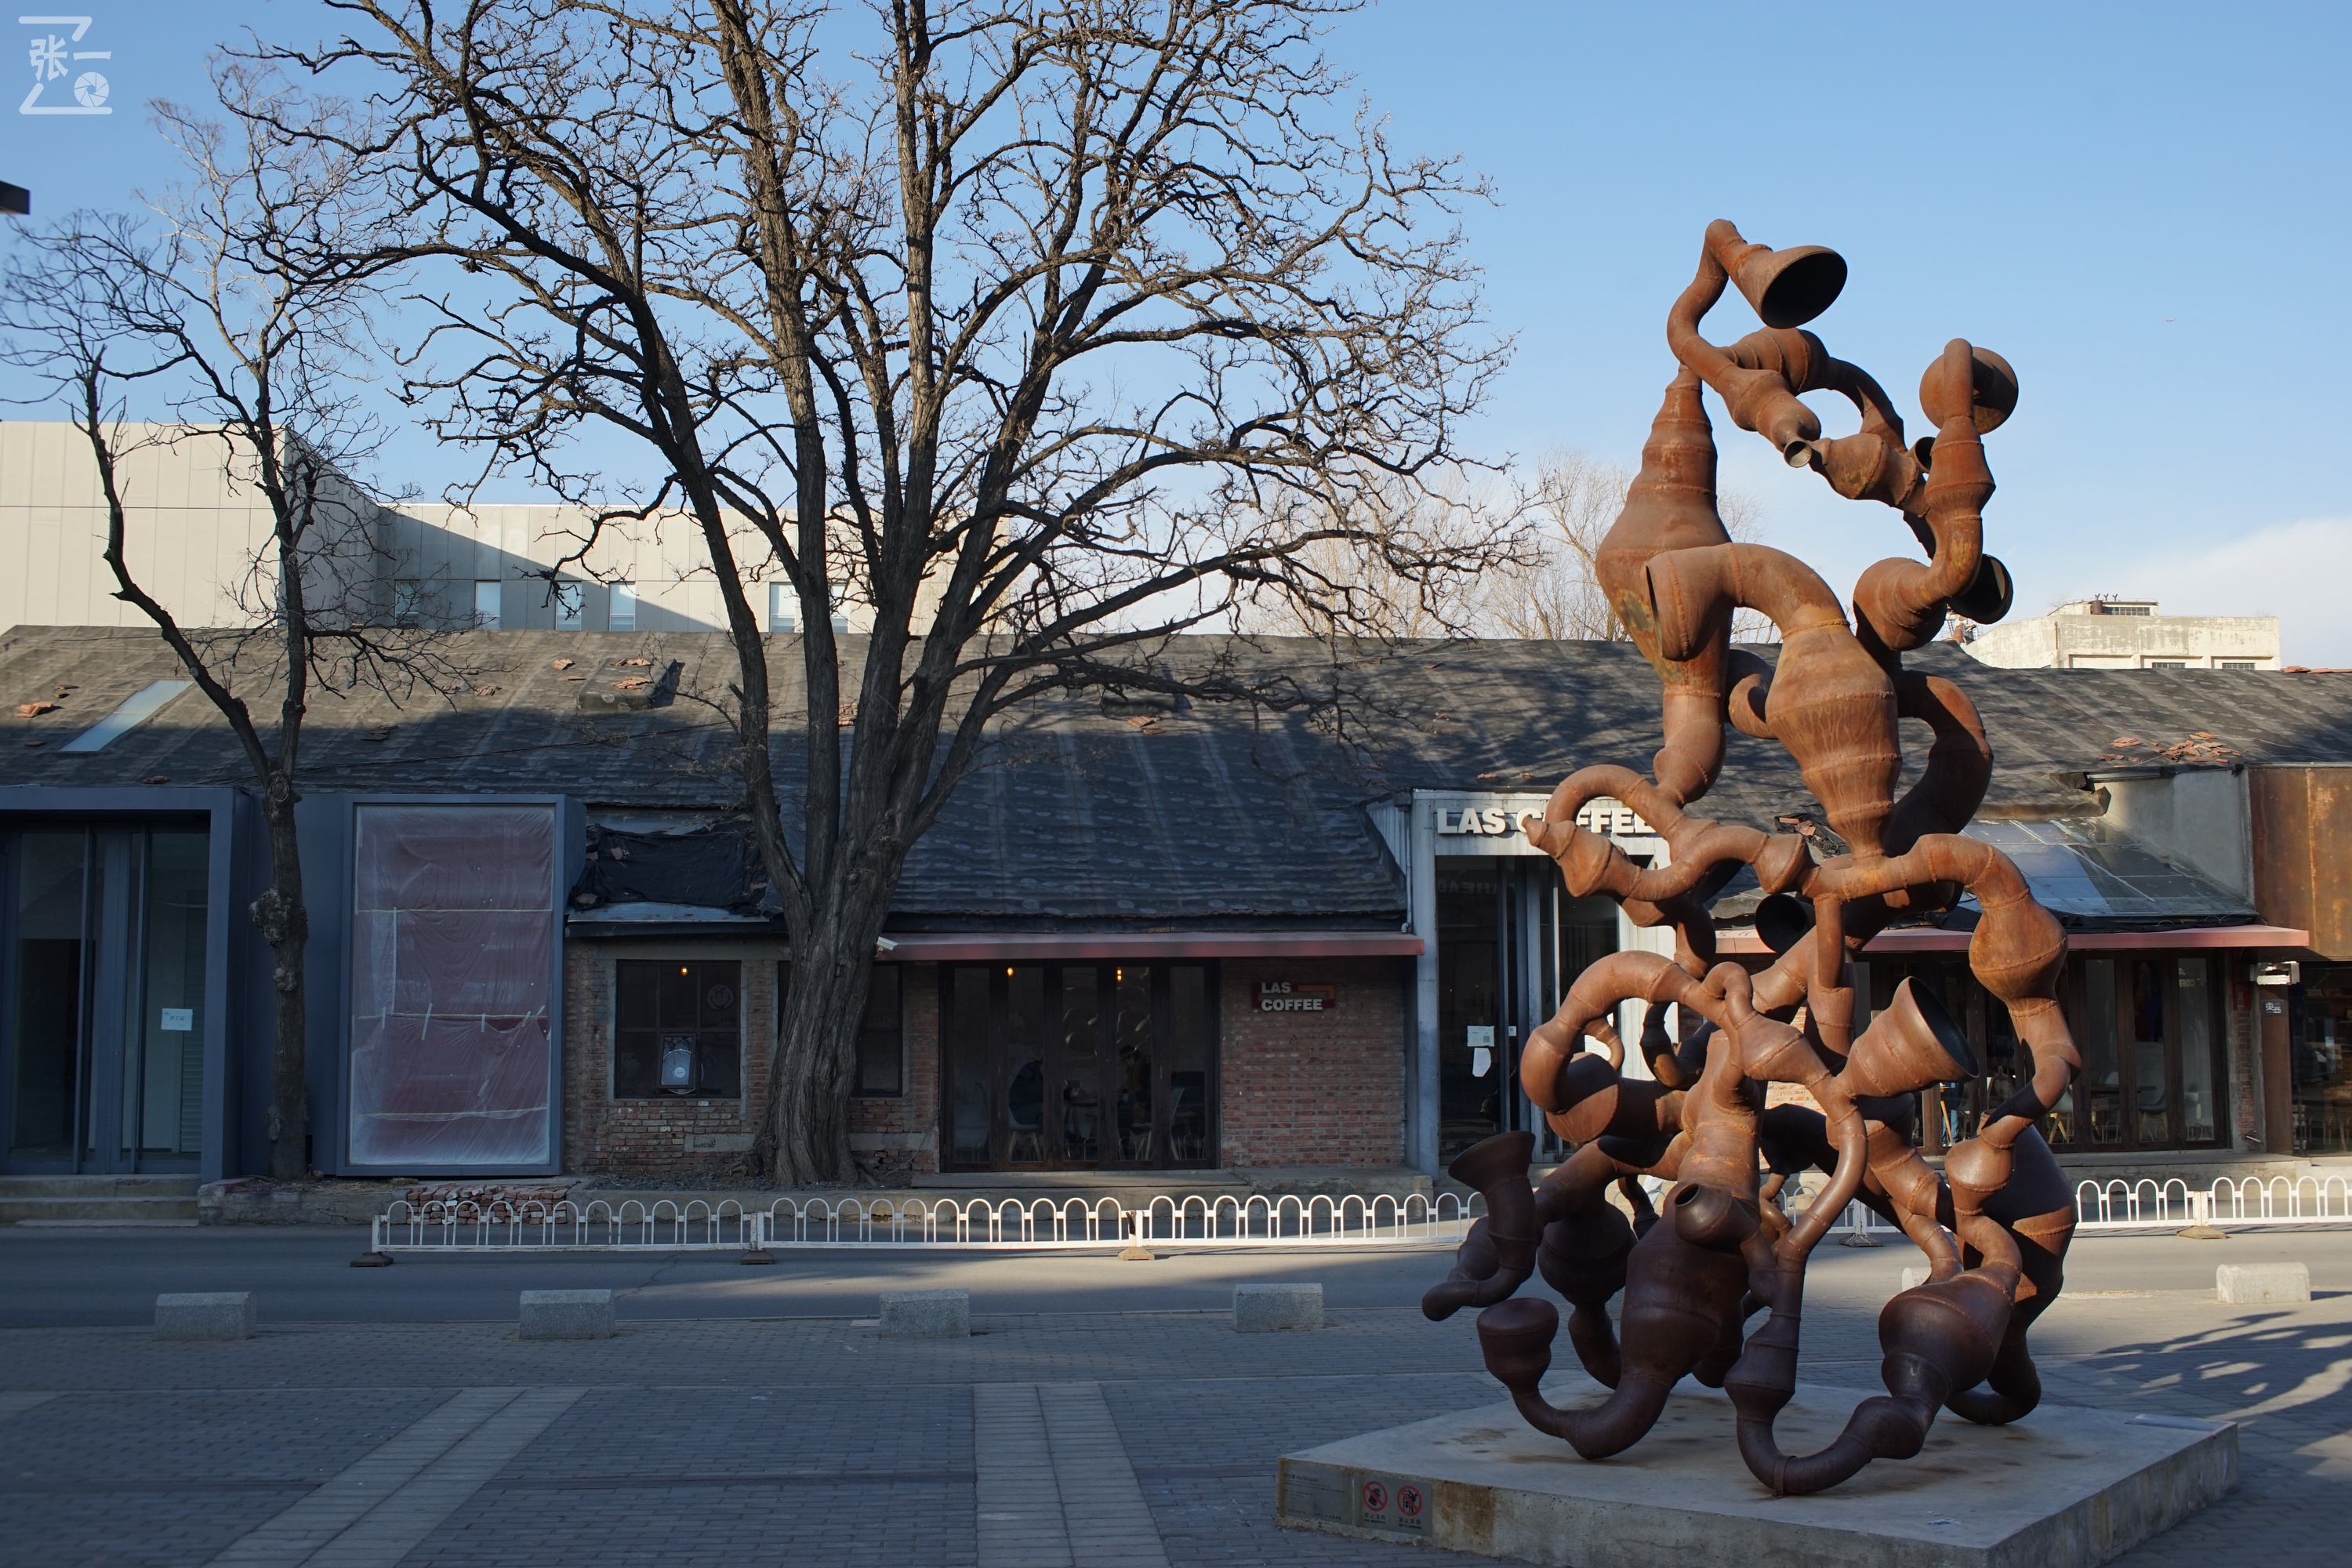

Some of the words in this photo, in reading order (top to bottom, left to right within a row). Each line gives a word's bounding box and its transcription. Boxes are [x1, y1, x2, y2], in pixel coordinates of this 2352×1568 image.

[1437, 808, 1506, 834] LAS
[1516, 807, 1656, 833] CFFE
[1261, 982, 1291, 993] LAS
[1261, 999, 1323, 1011] COFFEE
